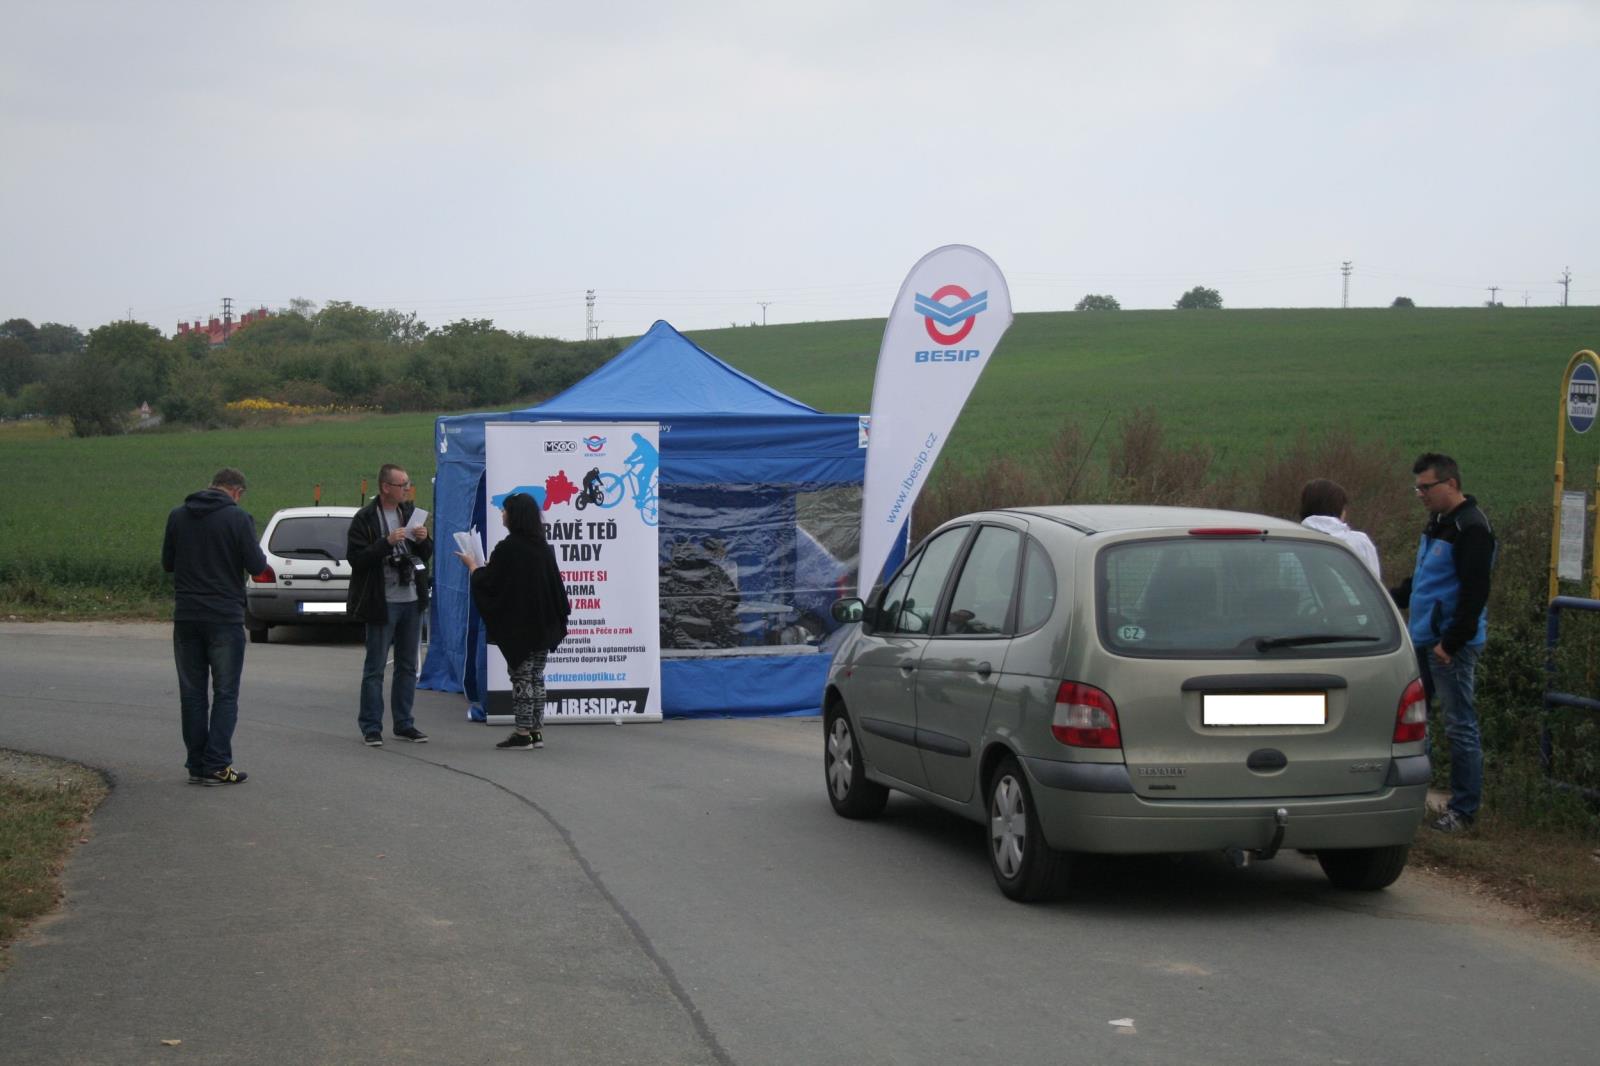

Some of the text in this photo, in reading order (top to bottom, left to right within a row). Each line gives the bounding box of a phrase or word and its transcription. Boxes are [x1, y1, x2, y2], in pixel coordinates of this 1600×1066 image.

[914, 350, 980, 363] BESIP
[886, 432, 938, 523] www.ibesip.cz
[542, 519, 617, 540] RÁVĚ TEĎ
[560, 544, 602, 561] TADY
[560, 570, 608, 582] STUJTE SI
[566, 584, 595, 596] ARMA
[575, 598, 601, 610] ZRAK
[579, 618, 606, 626] kampaň
[1124, 627, 1140, 639] CZ
[544, 672, 627, 682] .sdruzenioptiku.cz
[544, 697, 637, 714] w.iBESIP.cz
